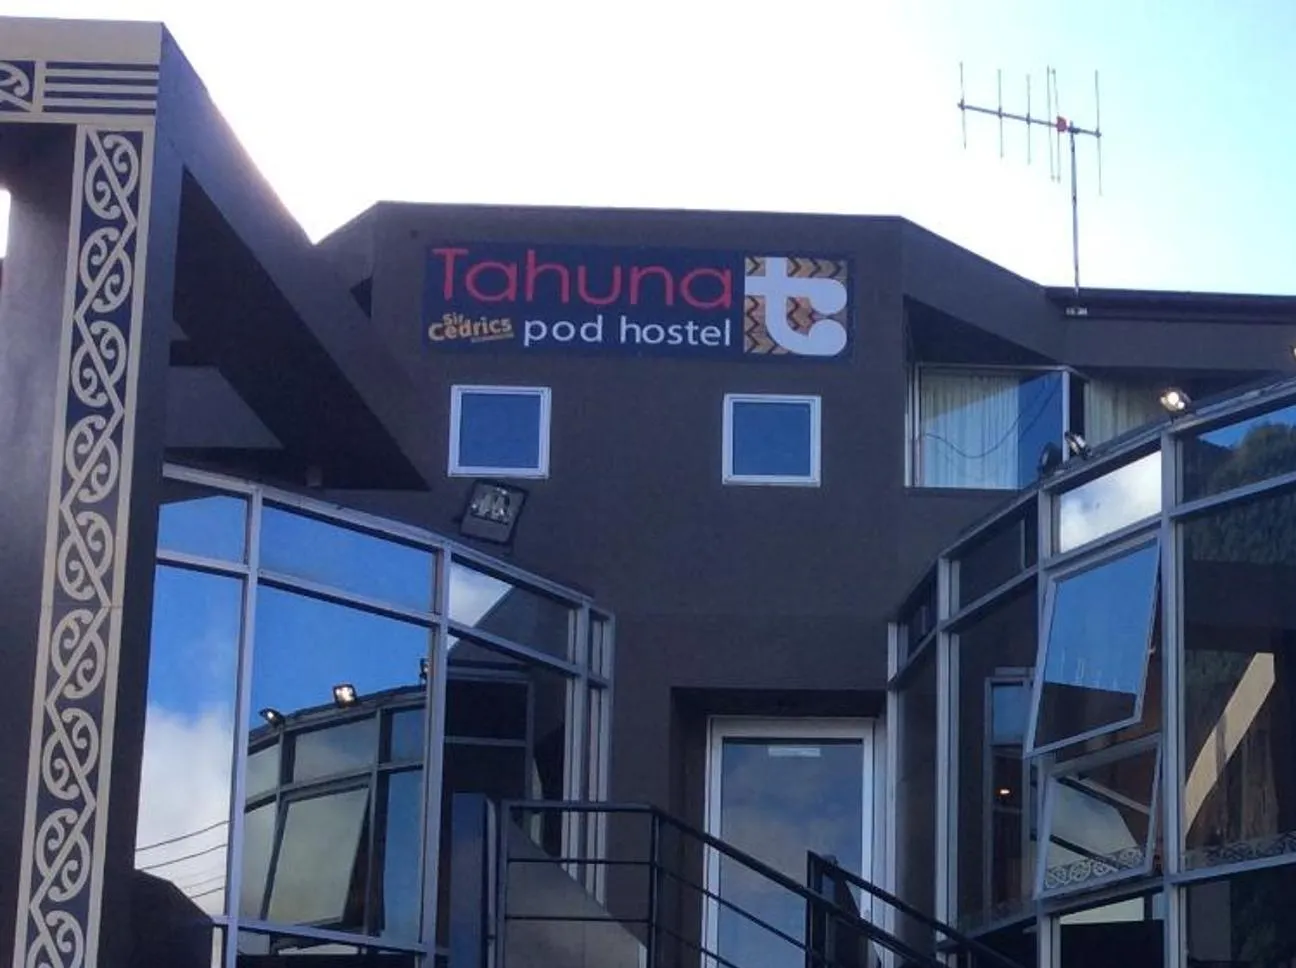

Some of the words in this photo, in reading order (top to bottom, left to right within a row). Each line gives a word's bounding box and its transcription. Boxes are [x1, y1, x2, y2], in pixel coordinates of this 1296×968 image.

[432, 247, 732, 310] Tahuna
[428, 317, 513, 341] Cedrics
[523, 315, 603, 346] pod
[619, 316, 732, 347] hostel
